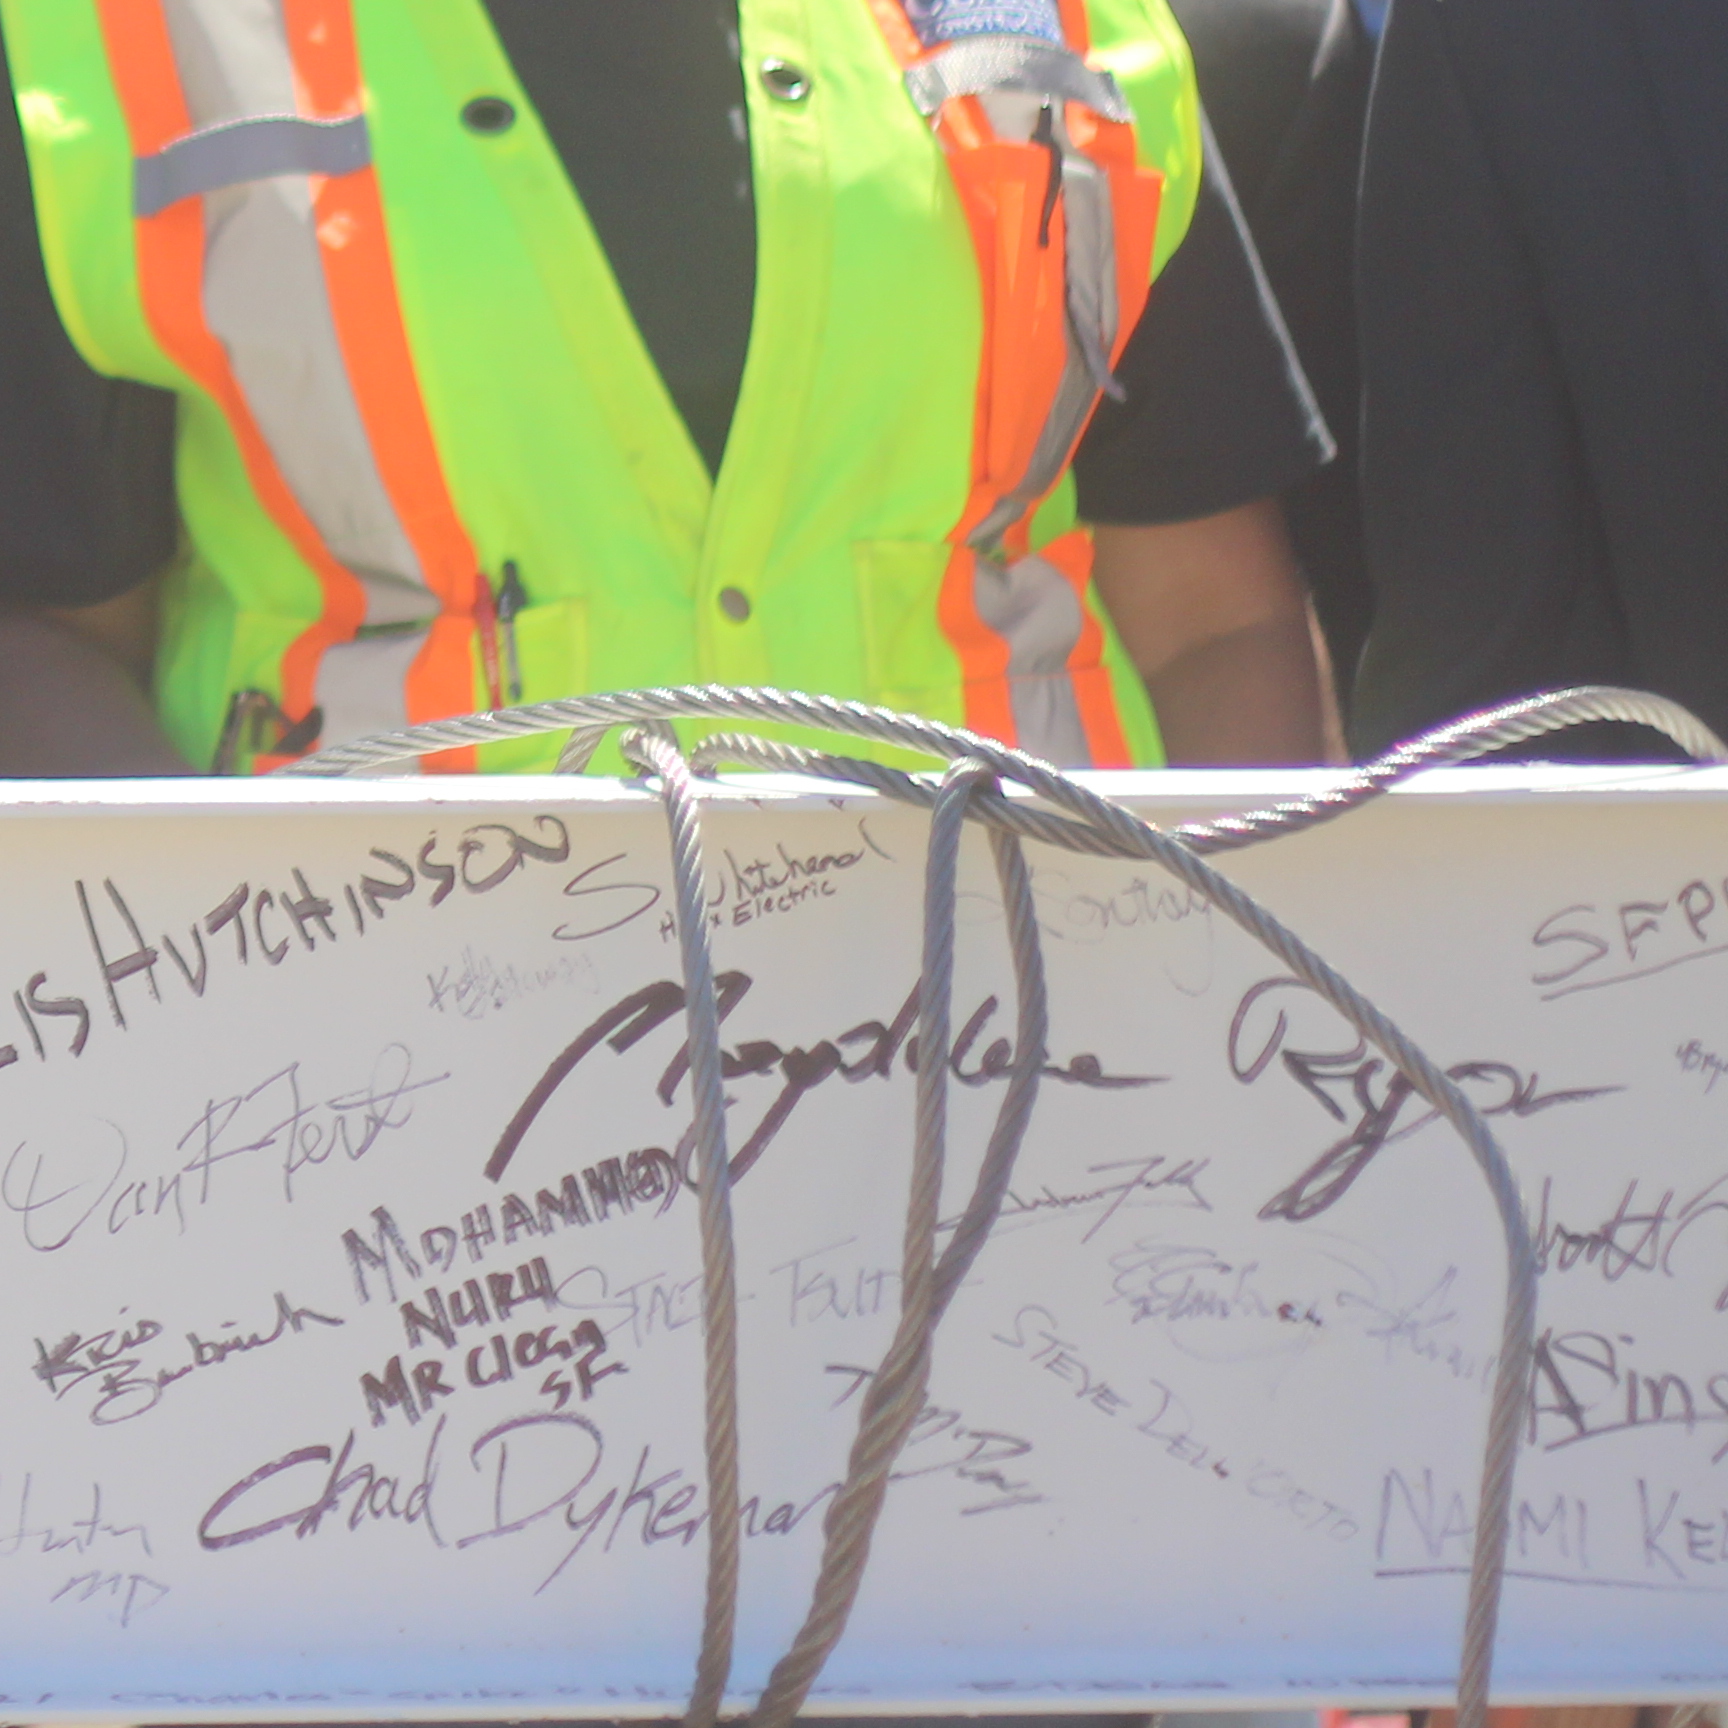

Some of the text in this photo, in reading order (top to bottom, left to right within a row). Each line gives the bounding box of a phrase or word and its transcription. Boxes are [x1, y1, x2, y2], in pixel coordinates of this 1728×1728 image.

[74, 814, 570, 1034] HUTCHINSON
[732, 879, 837, 928] Electric
[1531, 879, 1728, 985] SFP
